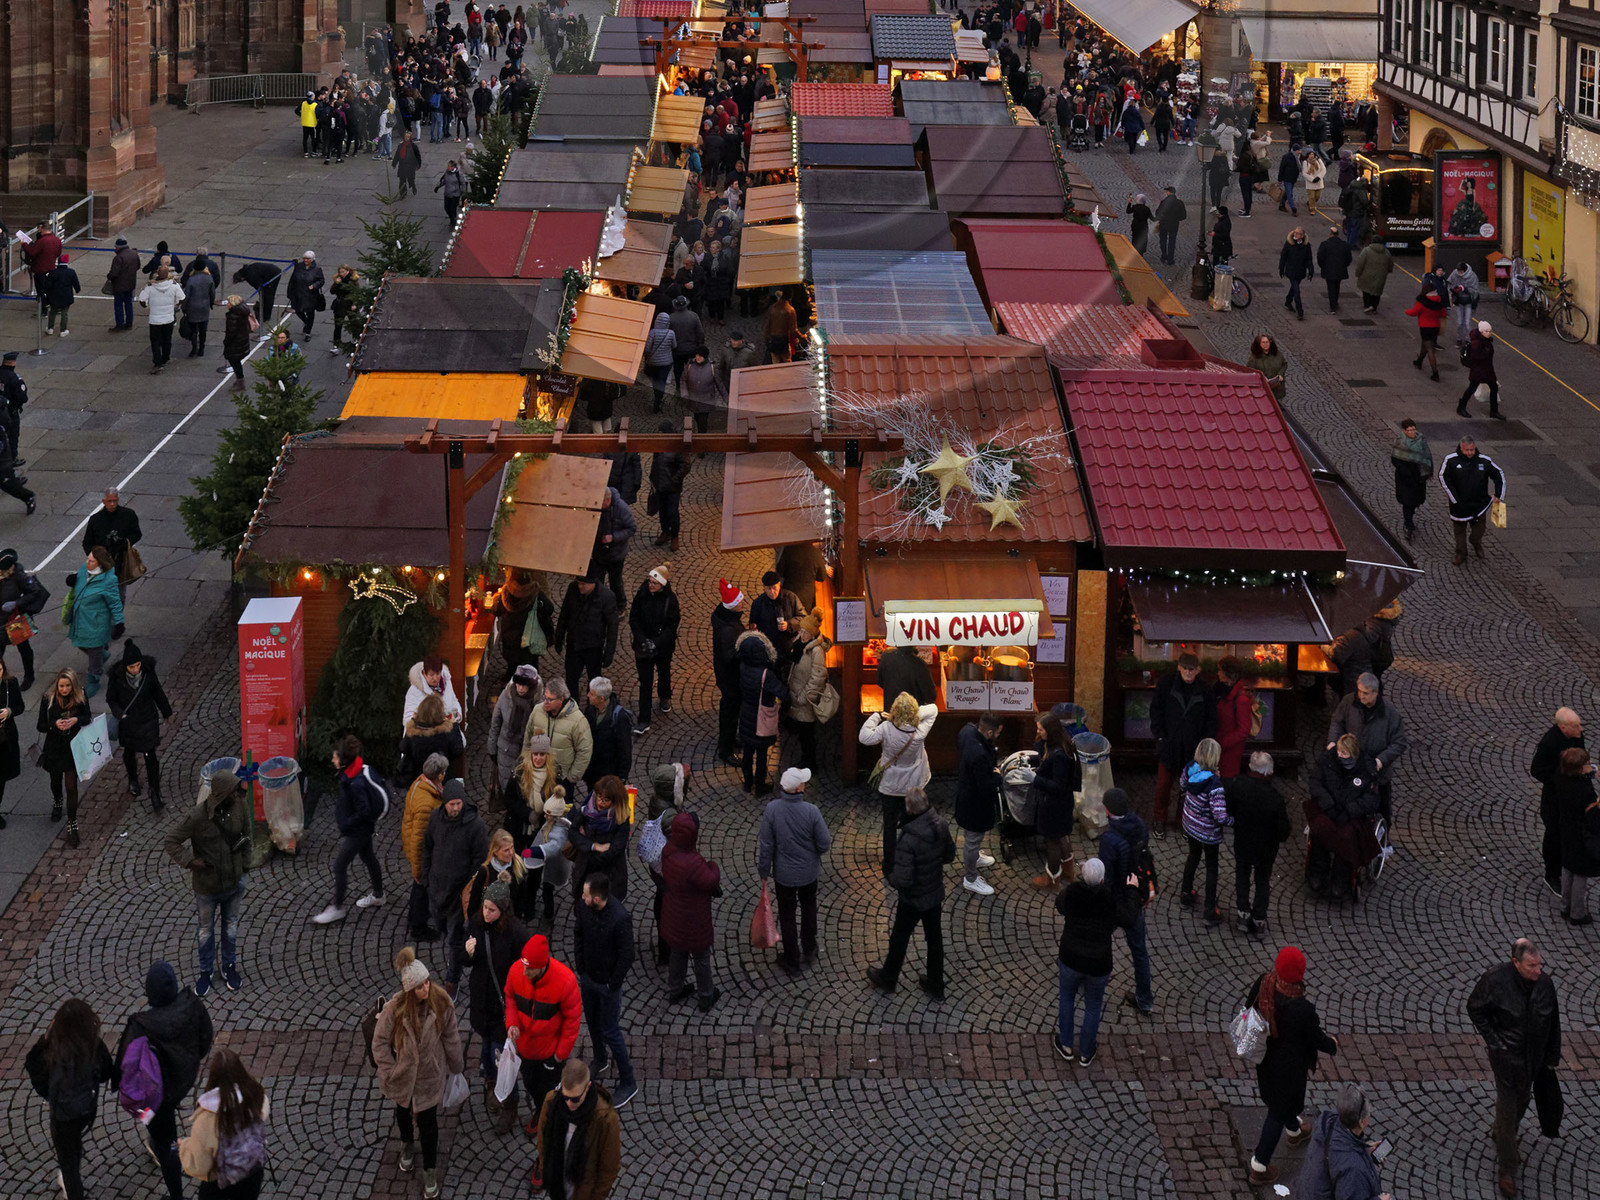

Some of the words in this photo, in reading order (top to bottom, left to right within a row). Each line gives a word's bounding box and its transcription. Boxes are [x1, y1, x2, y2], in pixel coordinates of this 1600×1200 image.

[1443, 168, 1462, 177] NOËL
[1464, 170, 1495, 178] MAGIQUE
[900, 617, 940, 641] VIN
[949, 611, 1025, 641] CHAUD
[252, 636, 277, 647] NOËL
[244, 650, 286, 659] MAGIQUE
[951, 685, 963, 694] Vin
[963, 685, 985, 695] Chaud
[994, 687, 1006, 695] Vin
[1007, 687, 1029, 696] Chaud
[955, 695, 980, 704] Rouge
[1000, 696, 1022, 705] Blanc
